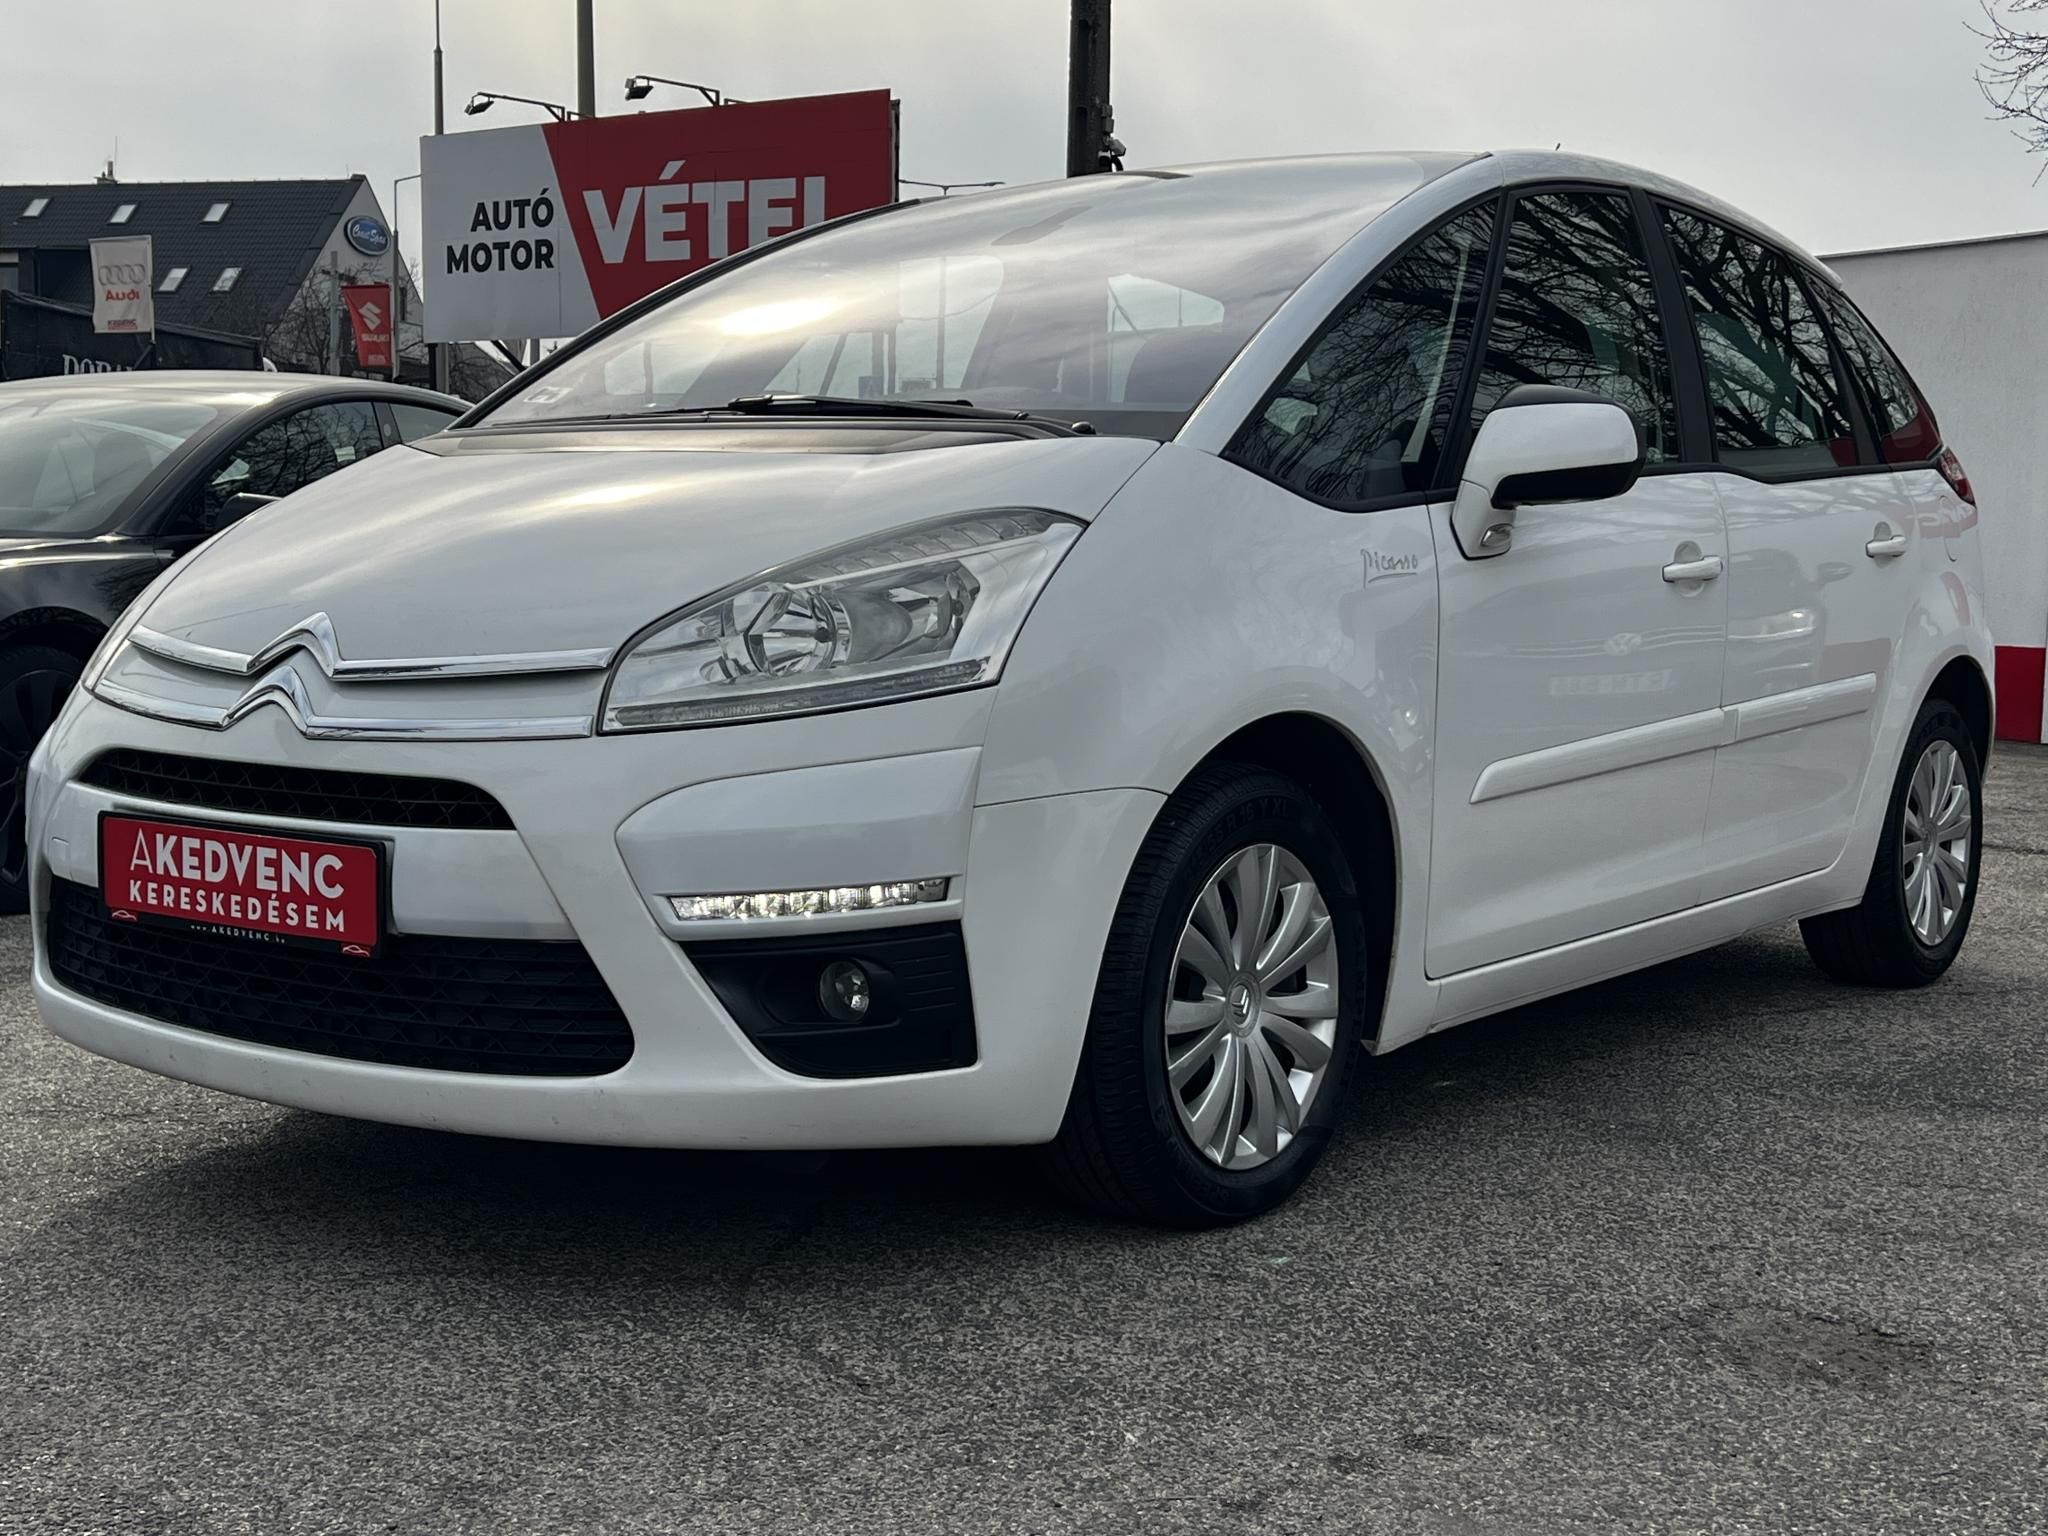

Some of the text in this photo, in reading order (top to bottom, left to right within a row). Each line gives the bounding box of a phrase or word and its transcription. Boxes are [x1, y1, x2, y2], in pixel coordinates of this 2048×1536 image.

[470, 188, 554, 232] AUTÓ
[446, 239, 554, 274] MOTOR
[106, 289, 140, 301] Audi
[129, 880, 345, 932] KERESKEDÉSEM
